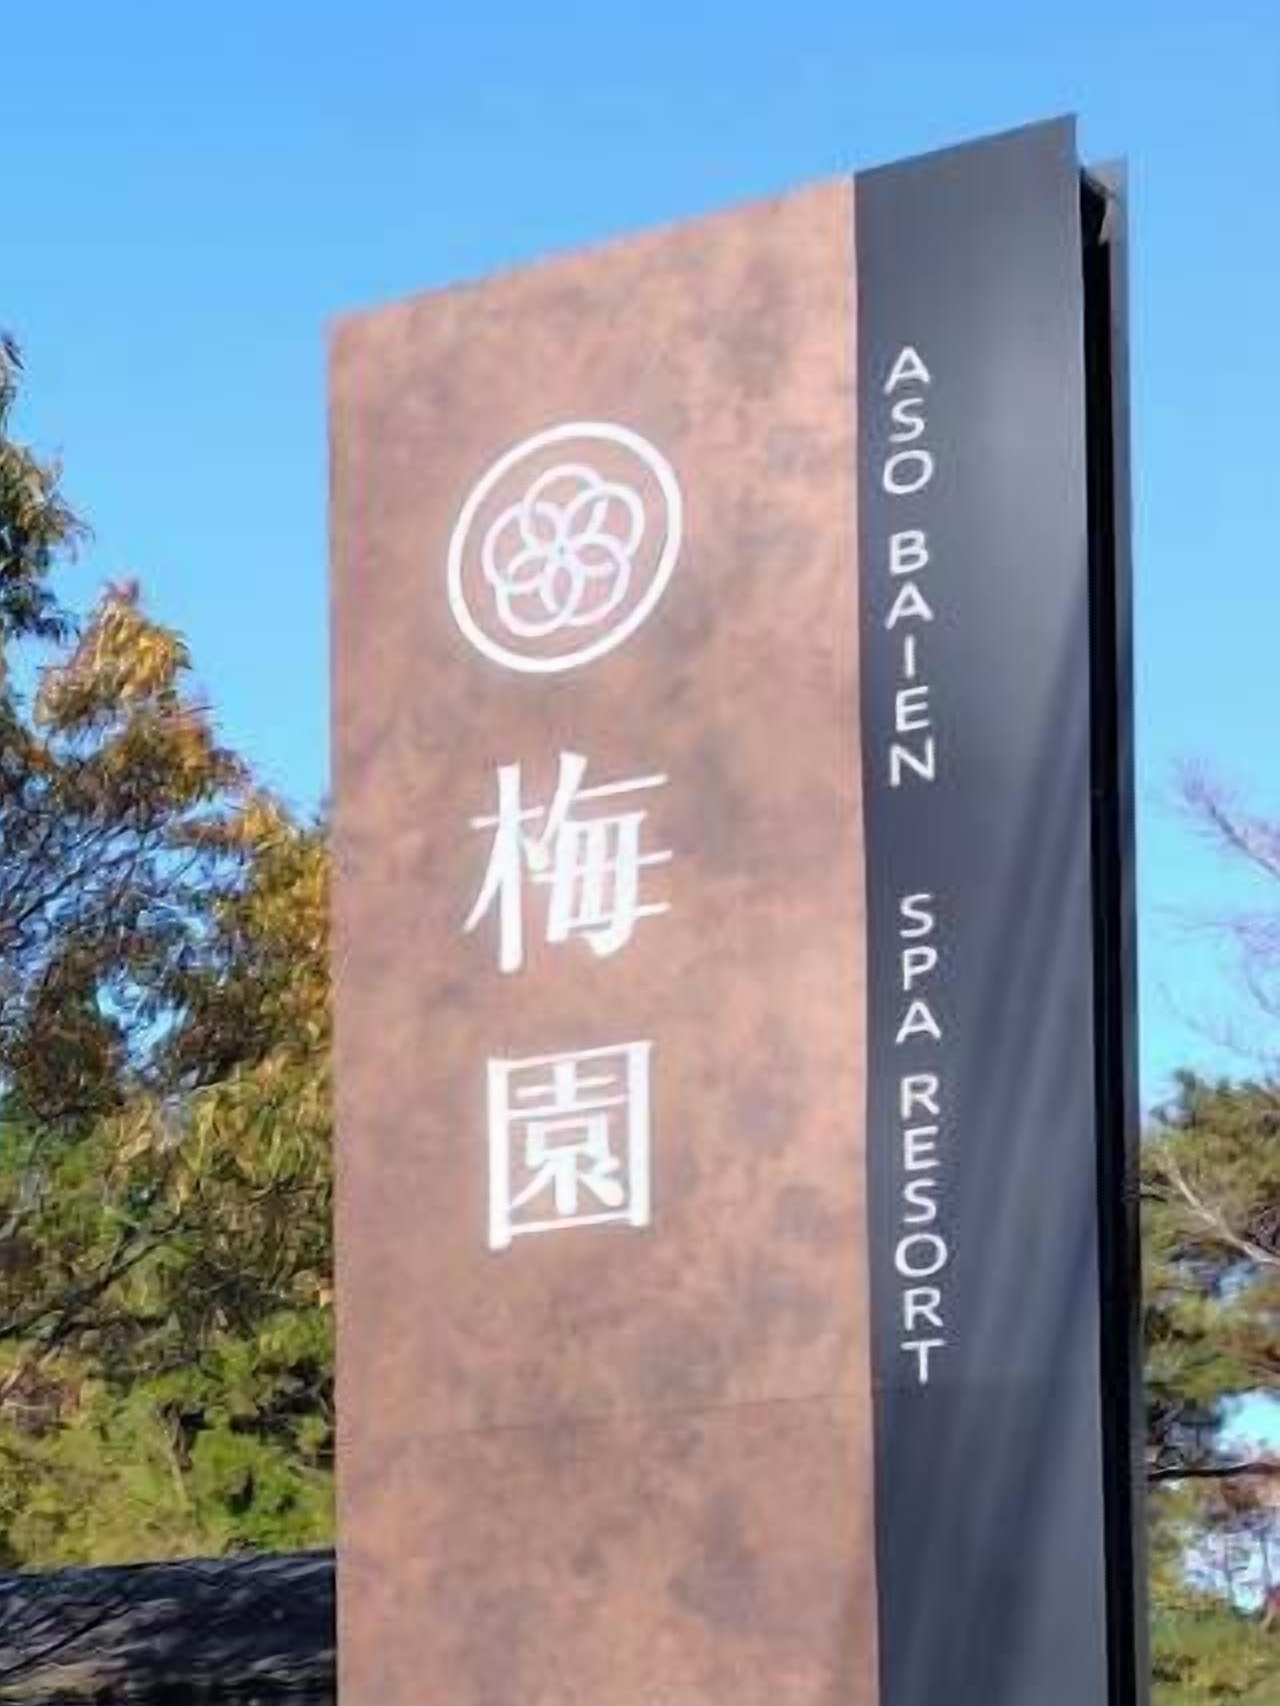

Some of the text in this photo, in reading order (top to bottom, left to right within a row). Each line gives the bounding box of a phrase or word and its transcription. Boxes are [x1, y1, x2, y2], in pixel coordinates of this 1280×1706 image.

[463, 749, 675, 1251] 梅園
[883, 345, 948, 1387] ASO BAIEN SPA RESORT
